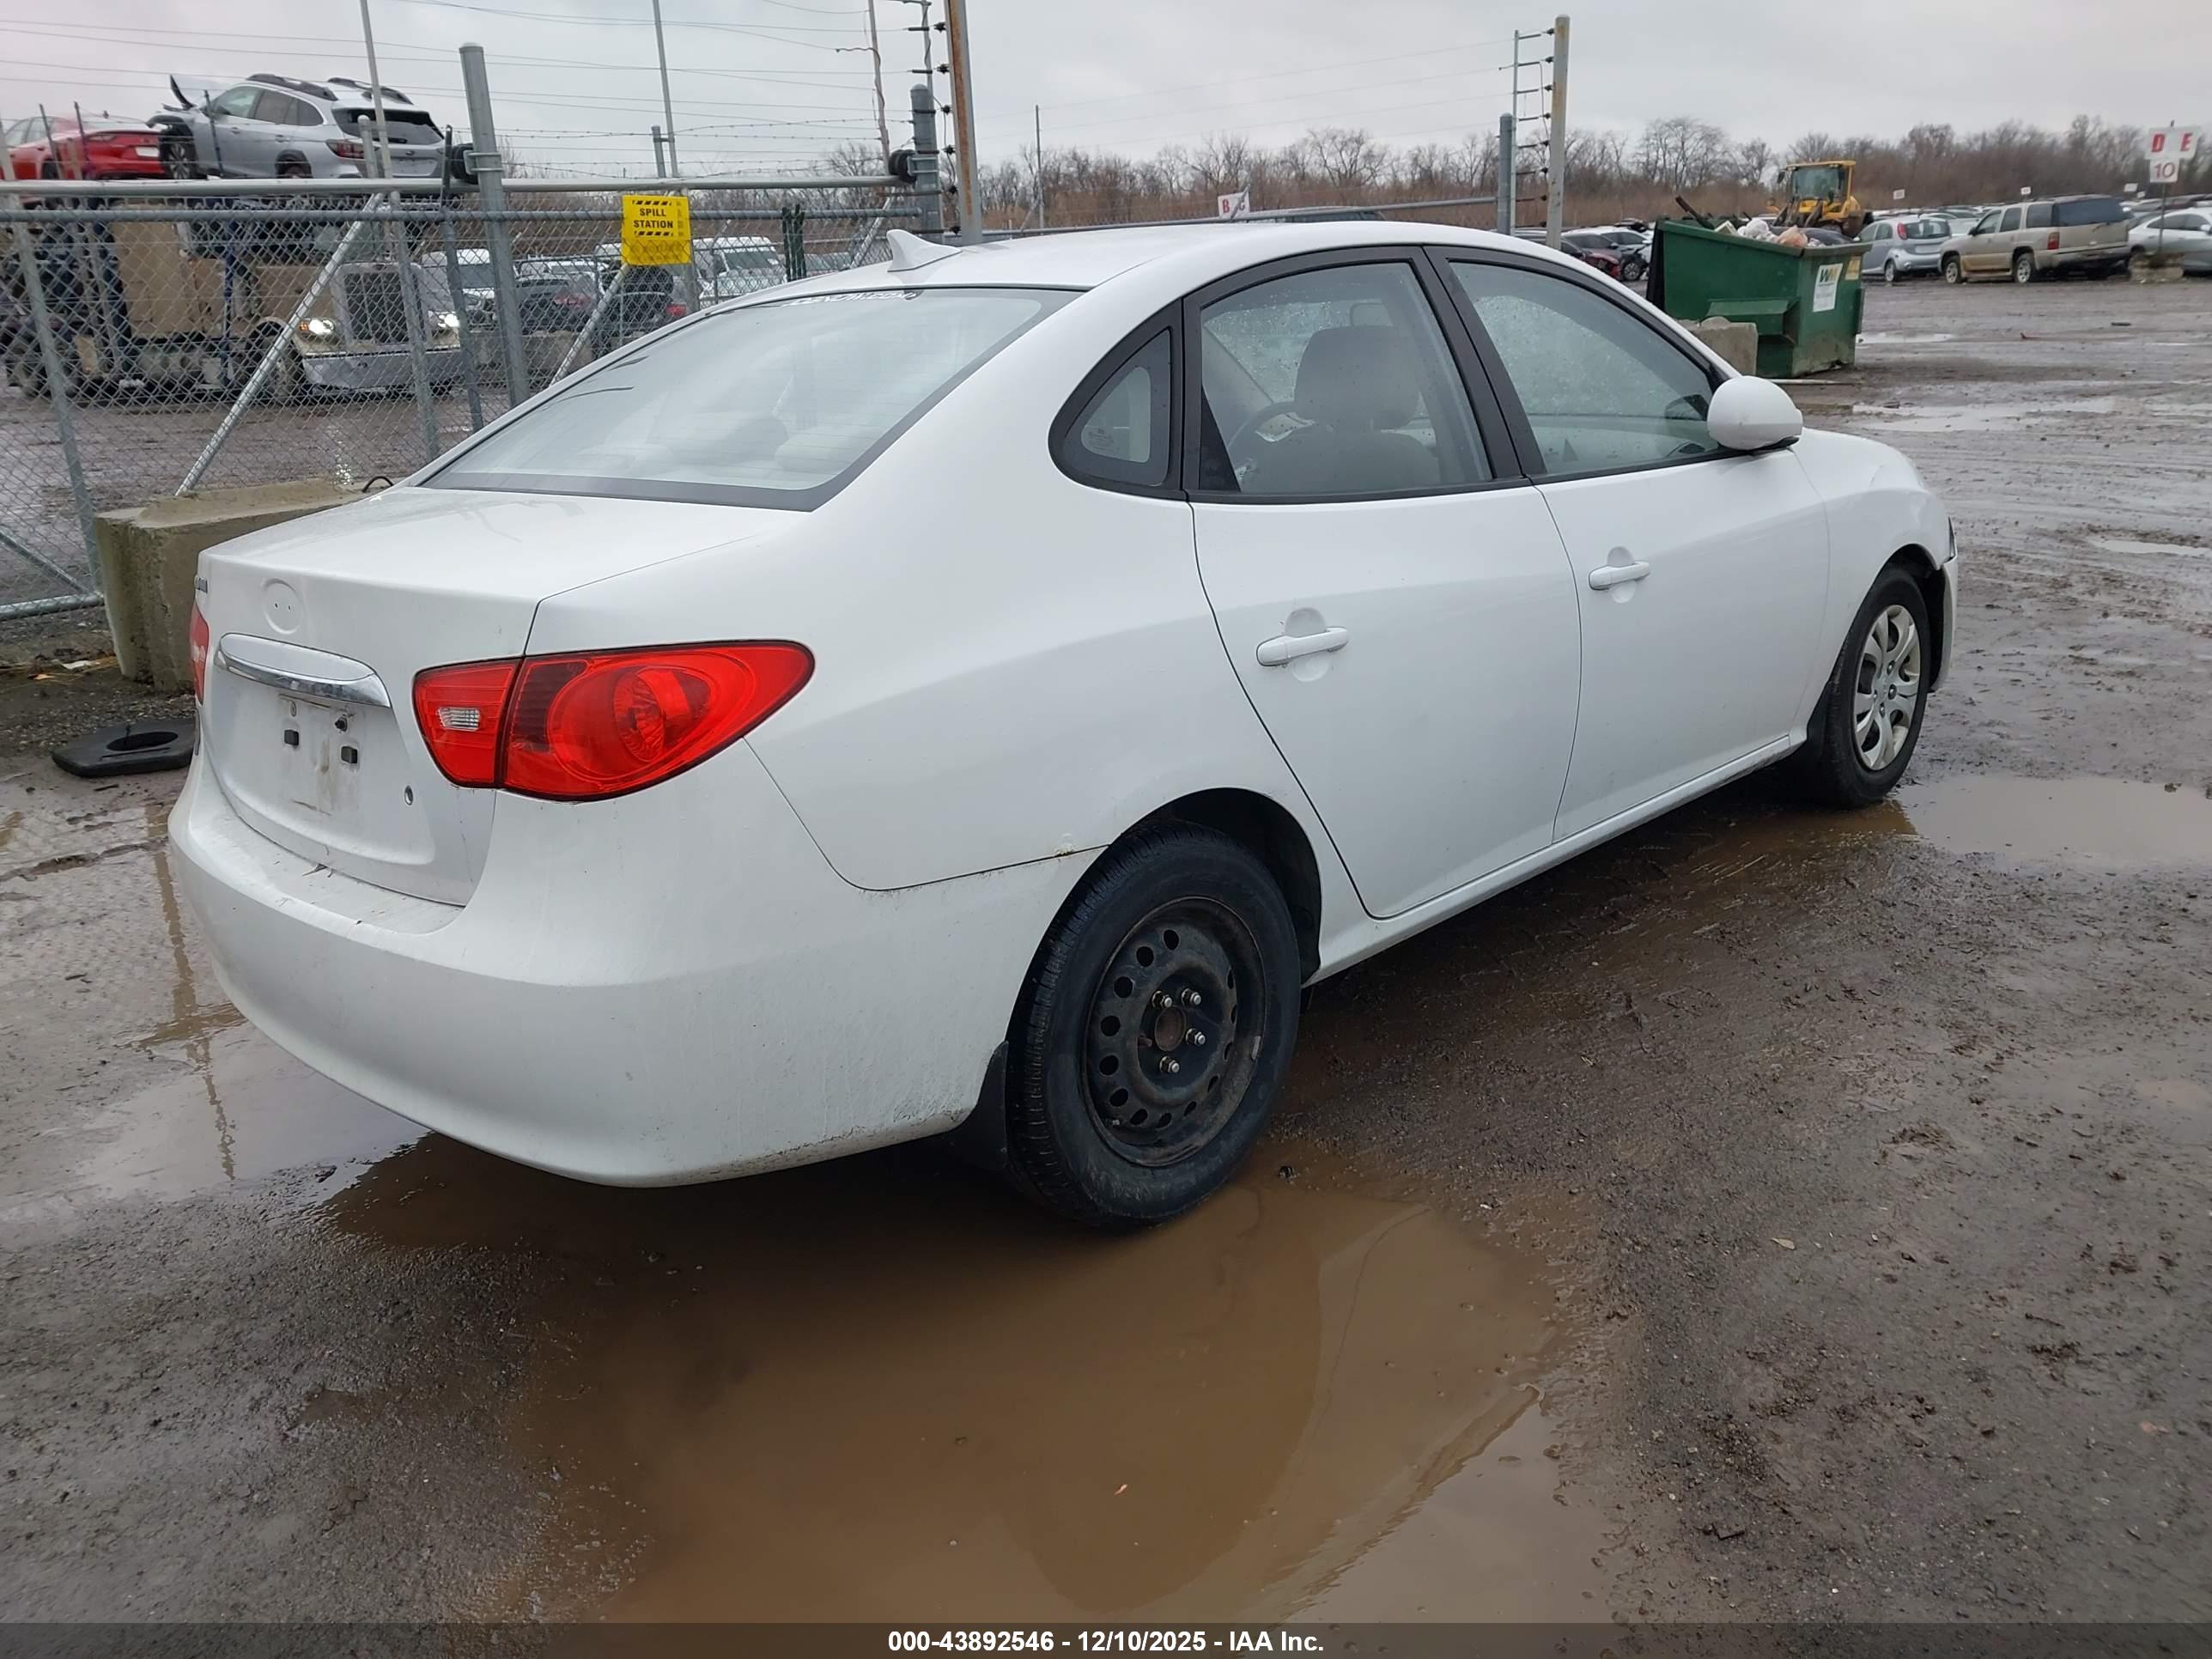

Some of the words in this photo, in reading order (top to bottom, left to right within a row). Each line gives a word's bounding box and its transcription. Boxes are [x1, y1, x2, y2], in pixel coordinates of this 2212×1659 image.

[2180, 132, 2193, 151] E
[2154, 161, 2176, 179] 10
[640, 208, 666, 217] SPILL
[1223, 199, 1231, 213] B
[634, 219, 673, 228] STATION
